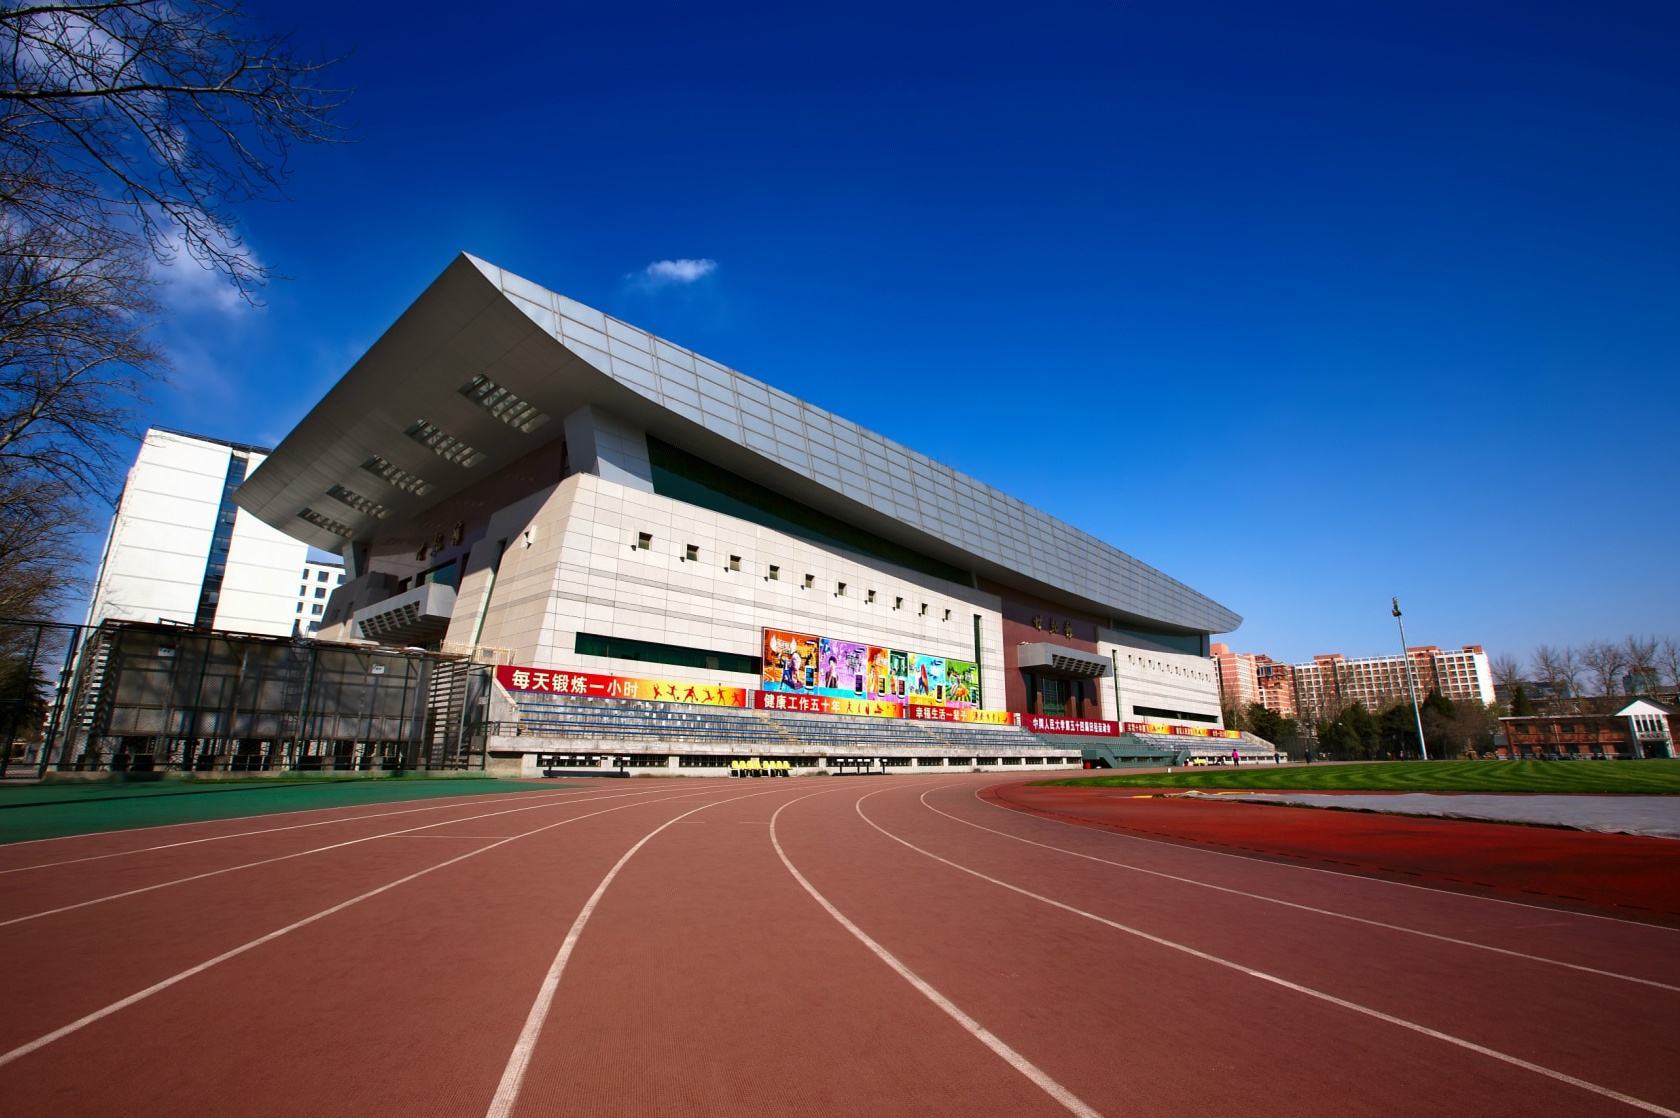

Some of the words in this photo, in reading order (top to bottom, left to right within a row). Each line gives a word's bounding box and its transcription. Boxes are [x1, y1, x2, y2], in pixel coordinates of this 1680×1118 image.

[512, 669, 639, 697] 每天锻炼一小时
[763, 694, 841, 712] 健康工作五十年
